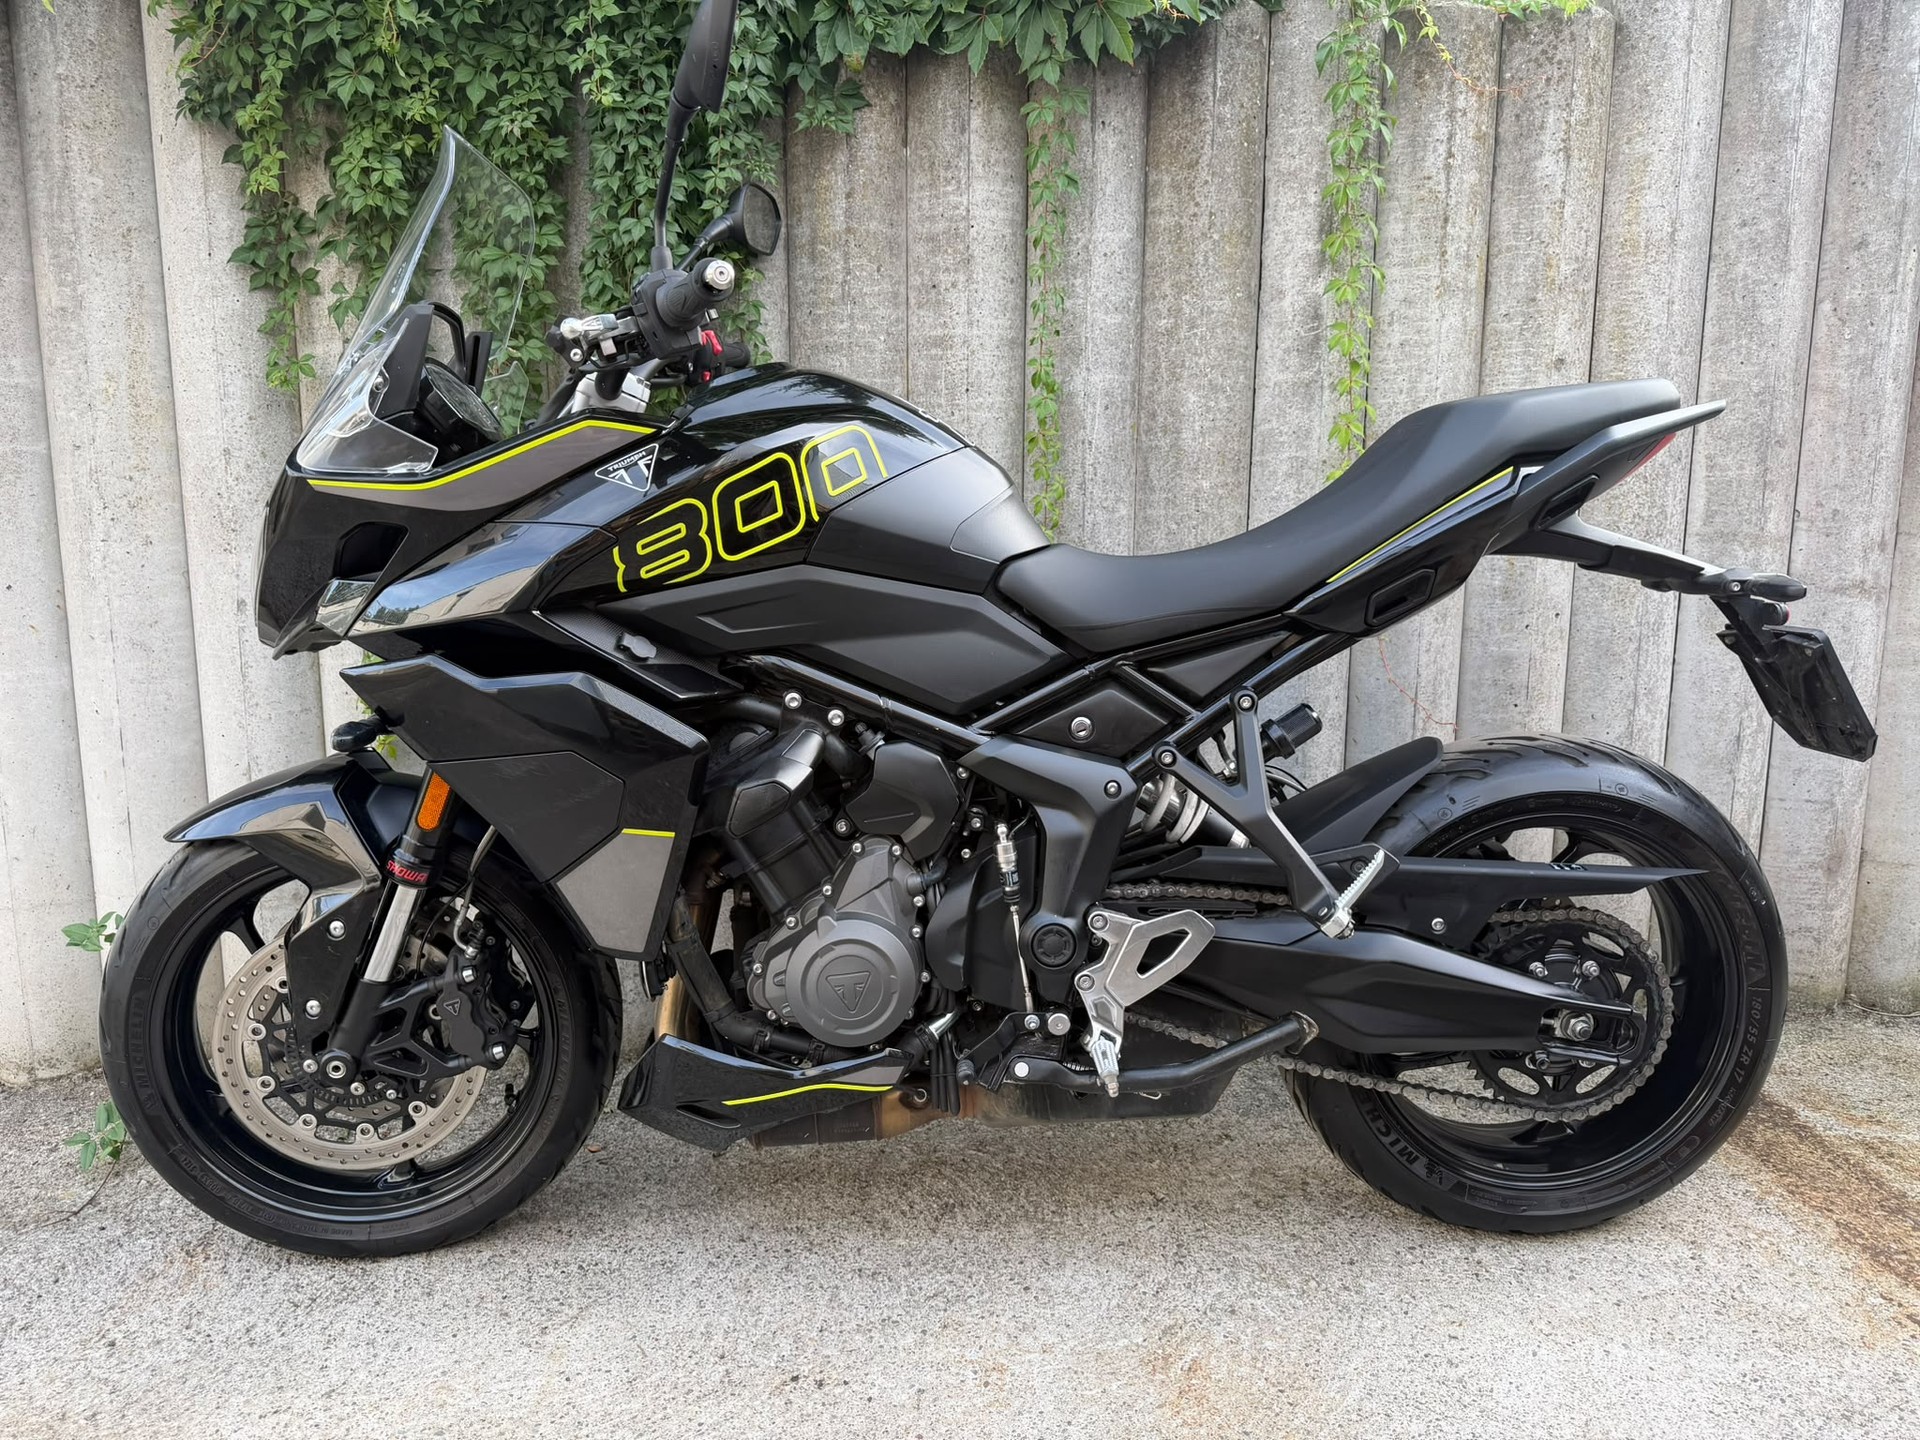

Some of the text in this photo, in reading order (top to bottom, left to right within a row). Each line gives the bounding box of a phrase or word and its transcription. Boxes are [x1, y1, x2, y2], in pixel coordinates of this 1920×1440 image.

[608, 451, 646, 471] TRIUMPH
[613, 425, 888, 592] 800
[387, 860, 428, 882] SHOWA
[131, 997, 150, 1089] MICHELIN
[1734, 996, 1763, 1084] 180/55 ZR 17
